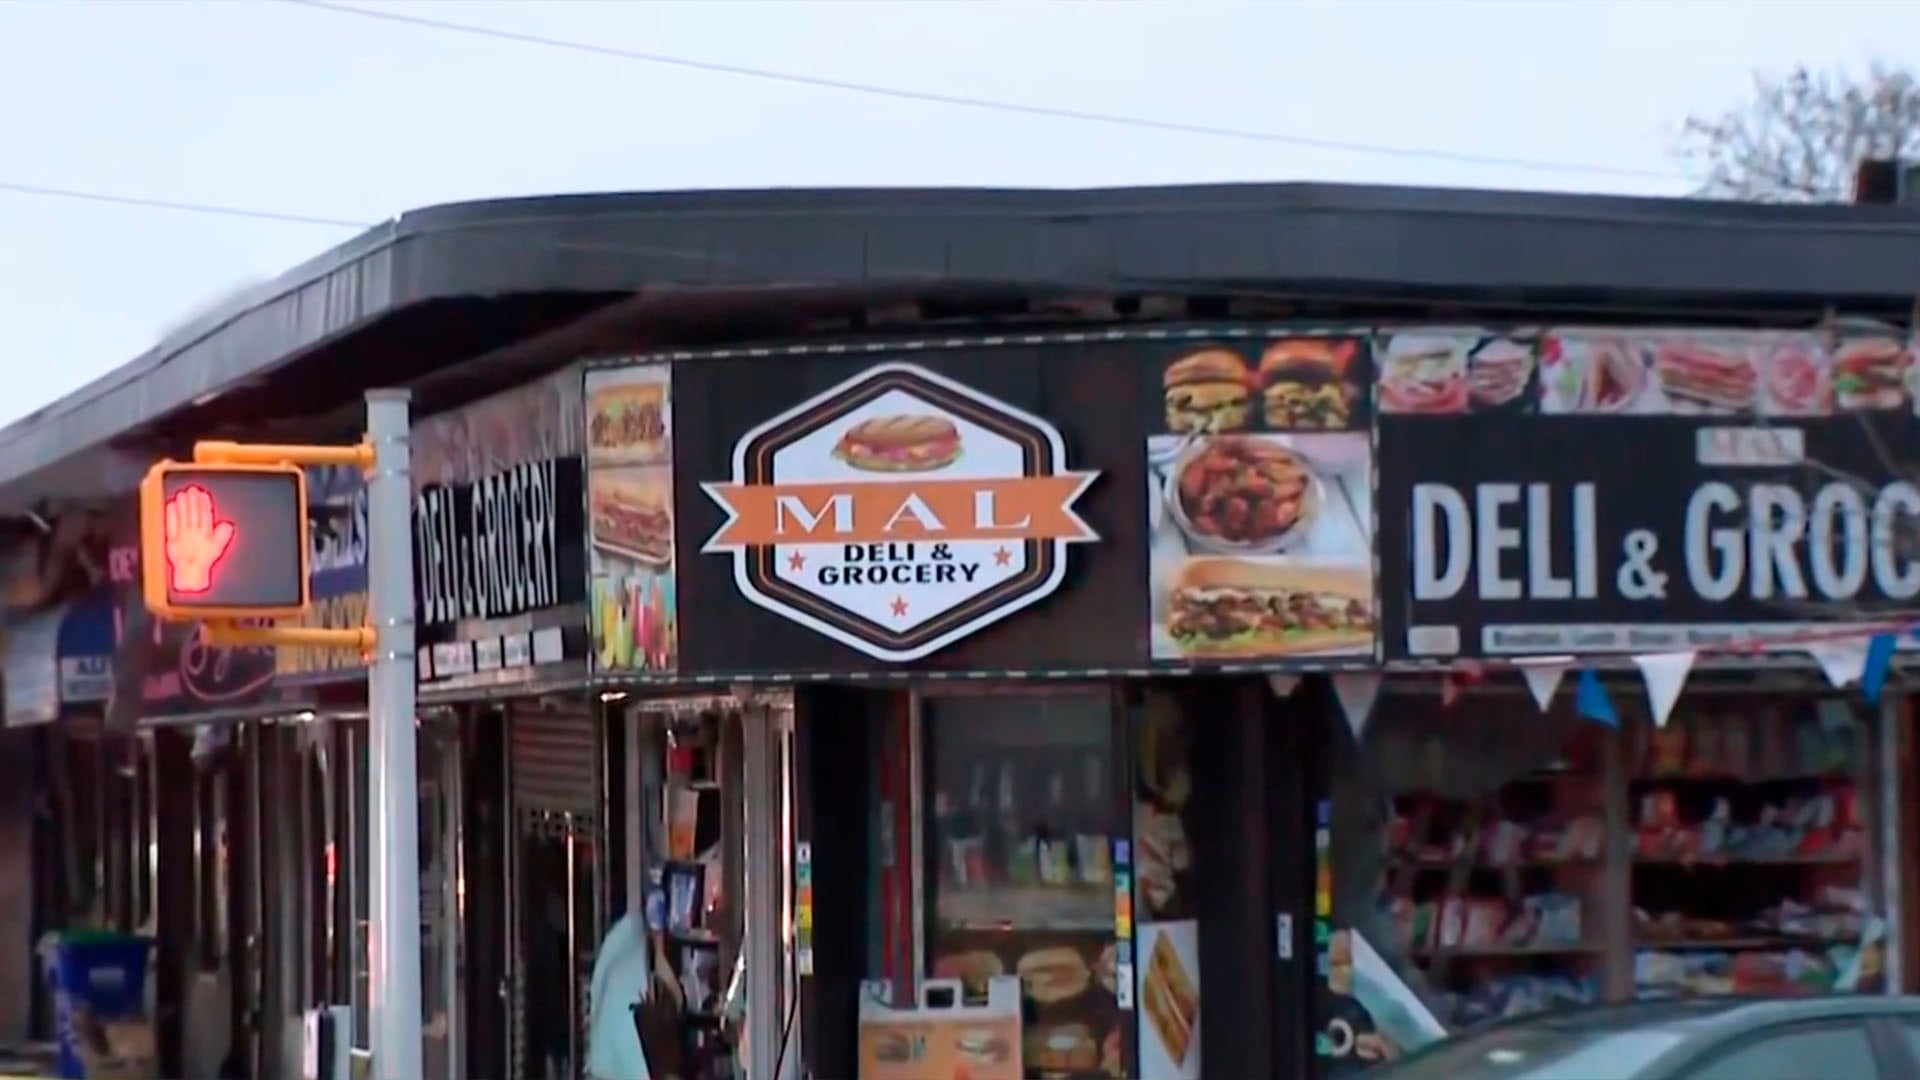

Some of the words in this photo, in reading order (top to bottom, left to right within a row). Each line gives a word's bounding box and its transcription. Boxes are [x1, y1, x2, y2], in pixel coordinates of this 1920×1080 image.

[774, 489, 1032, 535] MAL
[419, 486, 460, 624] DELI
[471, 458, 559, 620] GROCERY
[843, 543, 915, 563] DELI
[930, 542, 953, 561] &
[1412, 482, 1598, 600] DELI
[1617, 530, 1668, 599] &
[1684, 481, 1920, 601] GROC
[818, 562, 982, 586] GROCERY
